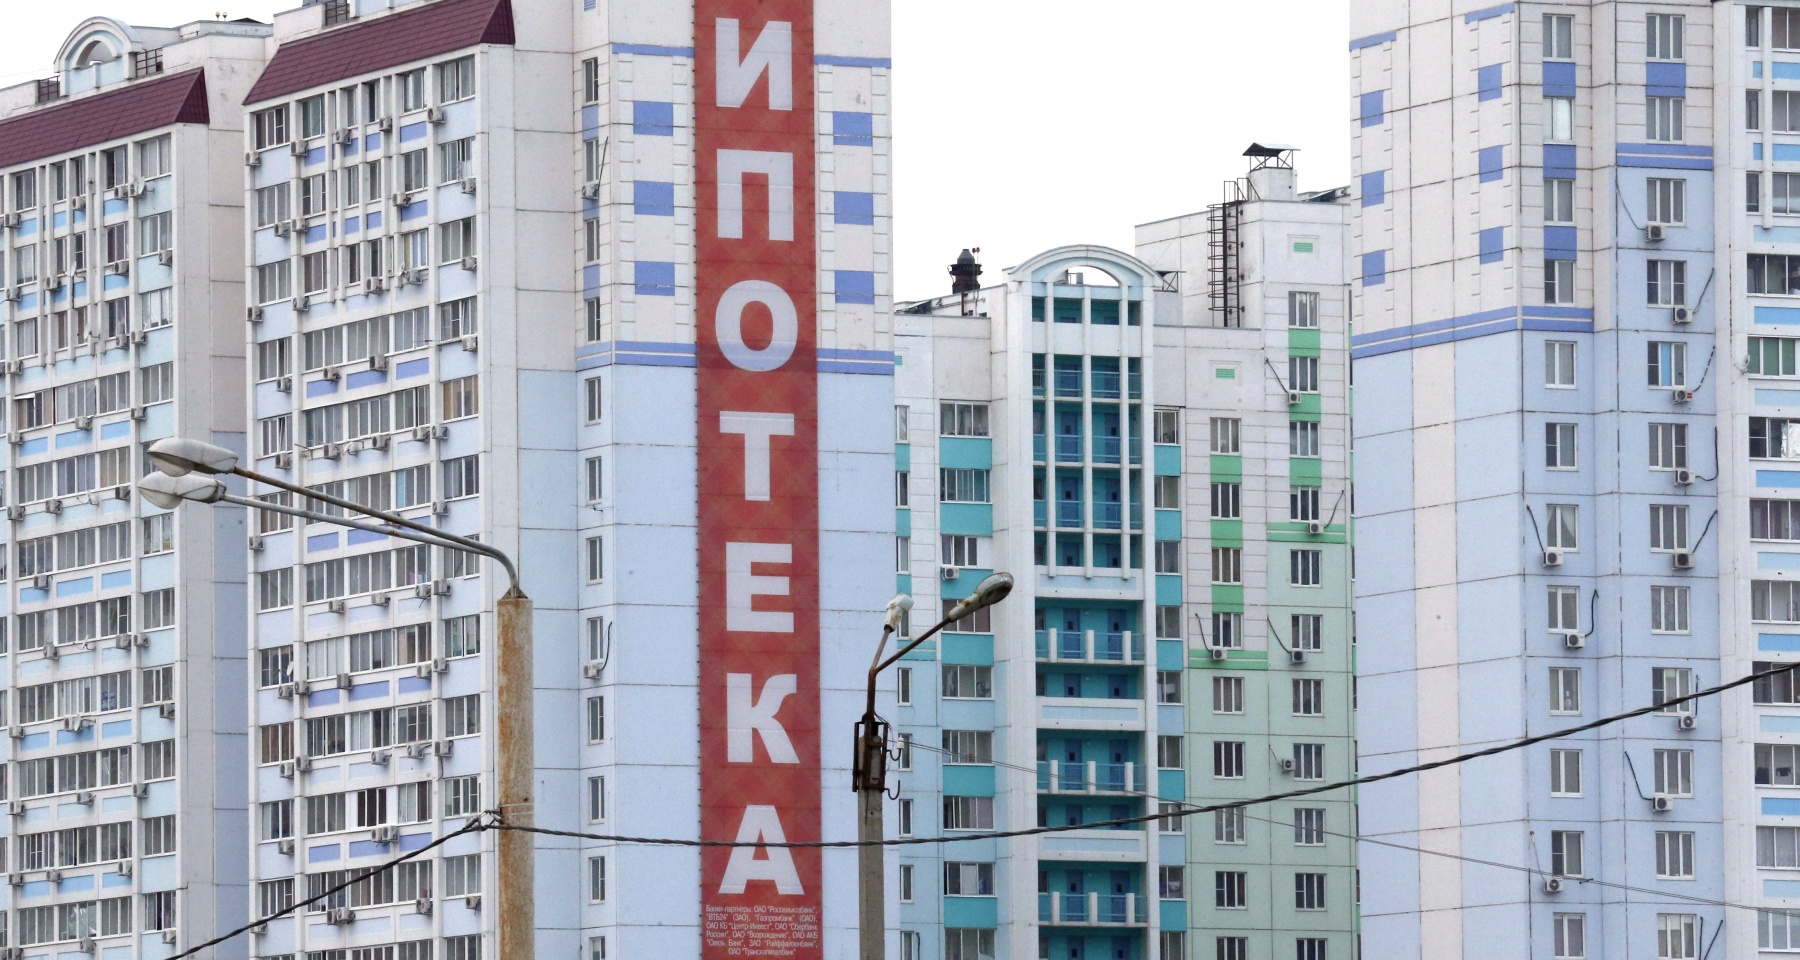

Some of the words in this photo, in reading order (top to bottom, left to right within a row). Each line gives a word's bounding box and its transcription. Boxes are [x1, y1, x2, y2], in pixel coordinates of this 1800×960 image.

[715, 17, 805, 895] ИПОТЕКА
[755, 914, 794, 922] "Газпромбанк"
[728, 939, 745, 947] Банк",
